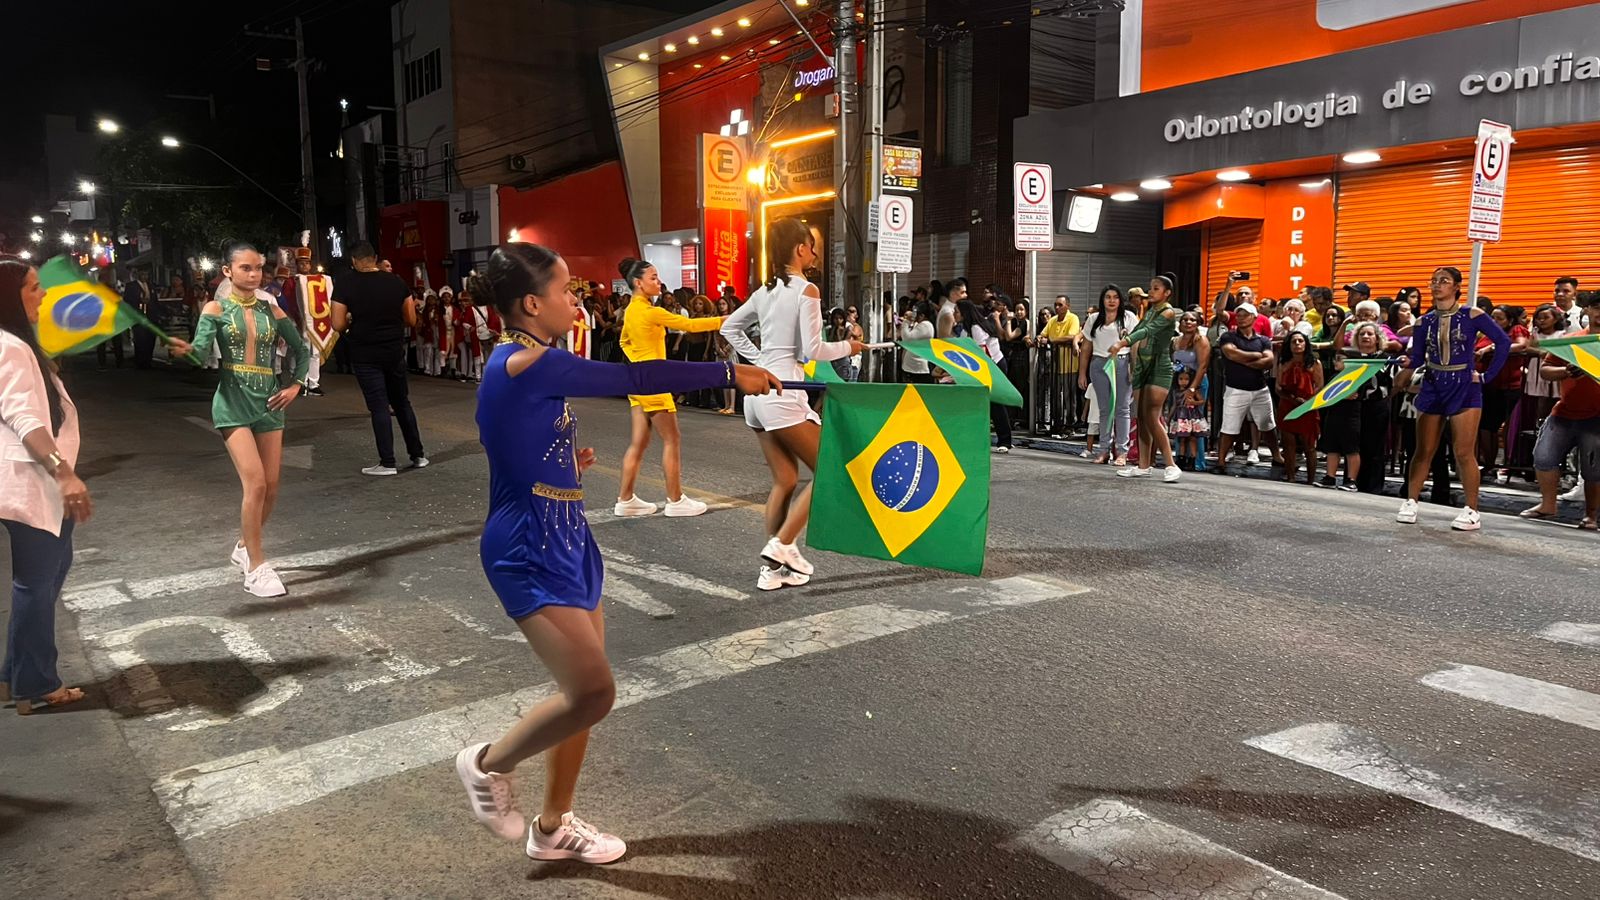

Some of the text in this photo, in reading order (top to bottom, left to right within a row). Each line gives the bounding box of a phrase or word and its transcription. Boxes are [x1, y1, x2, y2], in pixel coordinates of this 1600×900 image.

[1164, 52, 1600, 143] Odontologia de confia
[717, 149, 734, 174] E
[1487, 143, 1497, 168] E
[1029, 177, 1037, 195] E
[1473, 195, 1486, 204] ZONA
[1488, 197, 1500, 206] AZUL
[892, 207, 899, 223] E
[717, 230, 731, 281] Ultra
[730, 231, 739, 263] Popular
[1290, 206, 1305, 290] DENT
[570, 278, 591, 291] ais
